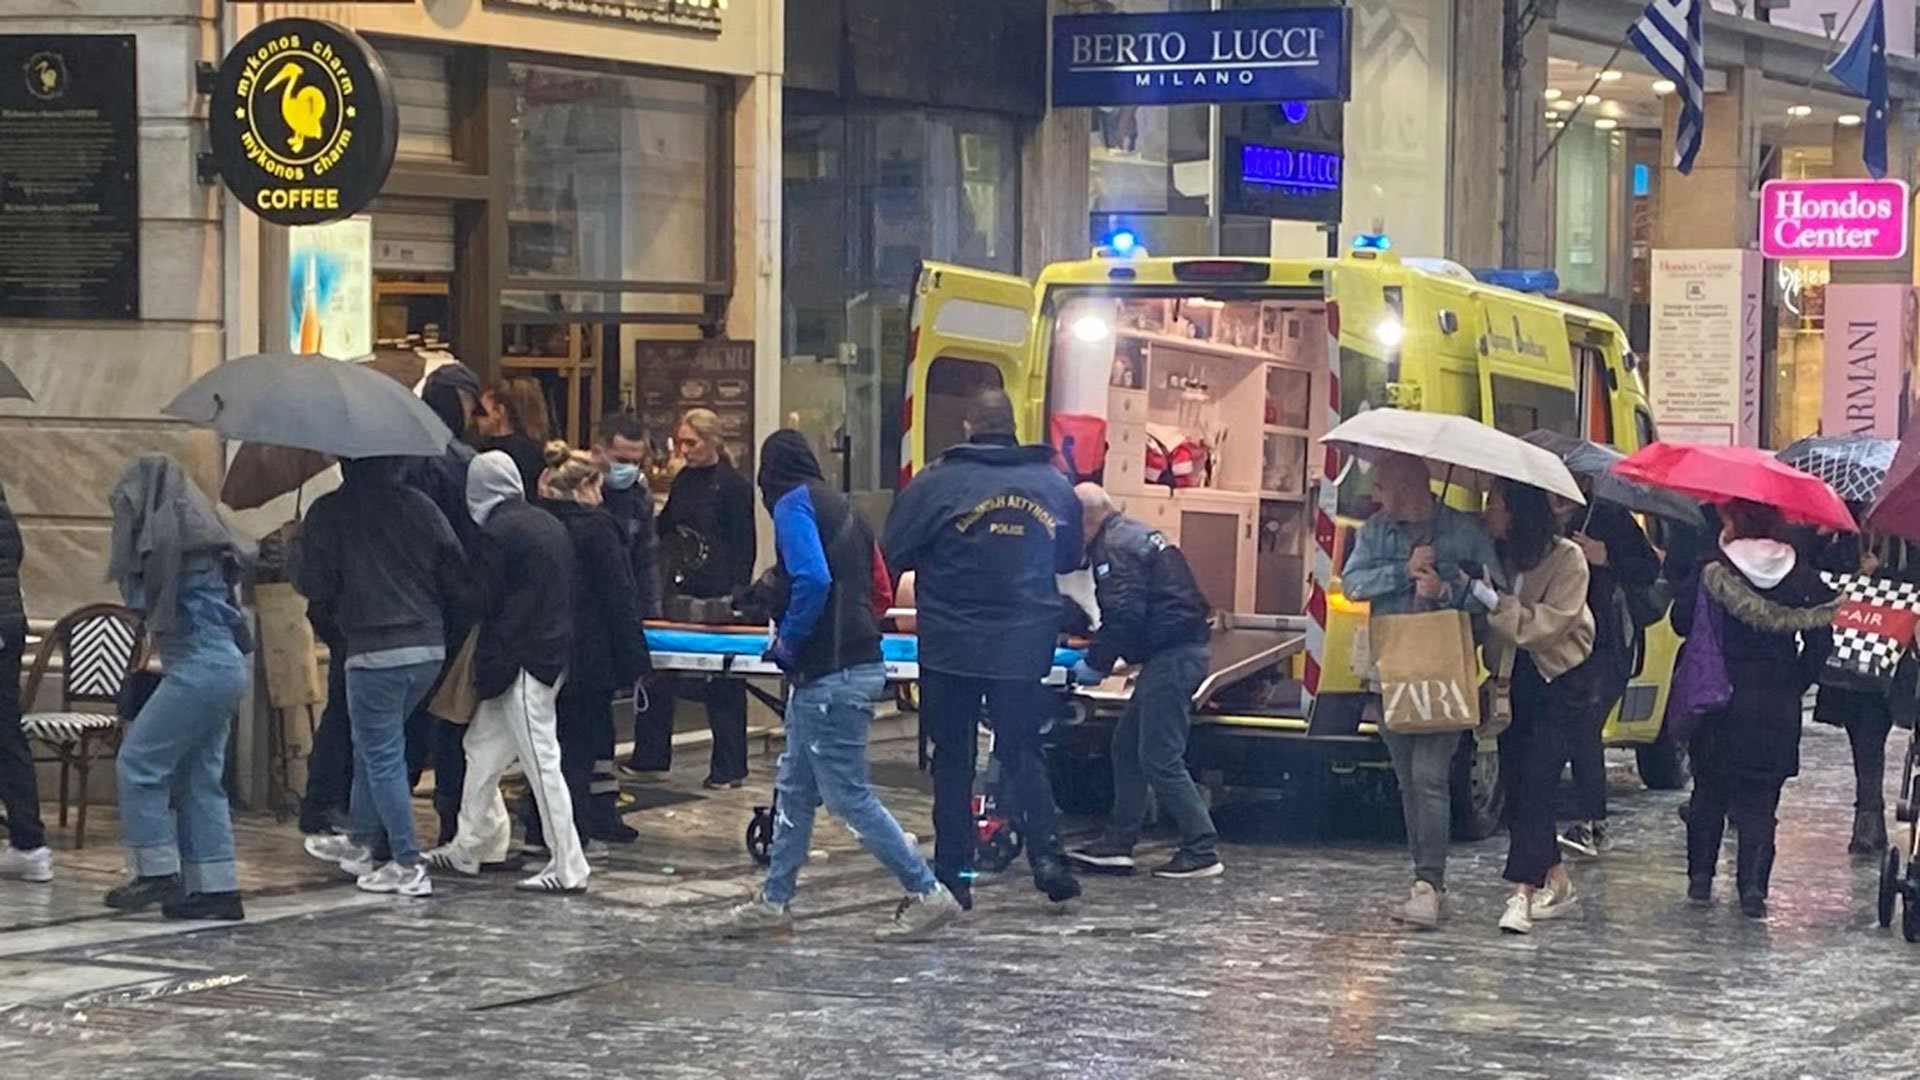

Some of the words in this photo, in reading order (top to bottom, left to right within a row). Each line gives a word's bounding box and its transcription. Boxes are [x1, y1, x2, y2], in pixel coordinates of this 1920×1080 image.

[1072, 32, 1186, 64] BERTO
[1212, 27, 1318, 60] LUCCI
[237, 35, 300, 97] mykonos
[313, 41, 353, 95] charm
[1136, 70, 1254, 86] MILANO
[241, 131, 304, 180] mykonos
[313, 128, 352, 175] charm
[257, 188, 339, 209] COFFEE
[1775, 190, 1892, 219] Hondos
[1774, 219, 1880, 248] Center
[989, 523, 1025, 535] POLICE
[1381, 679, 1470, 723] ZARA
